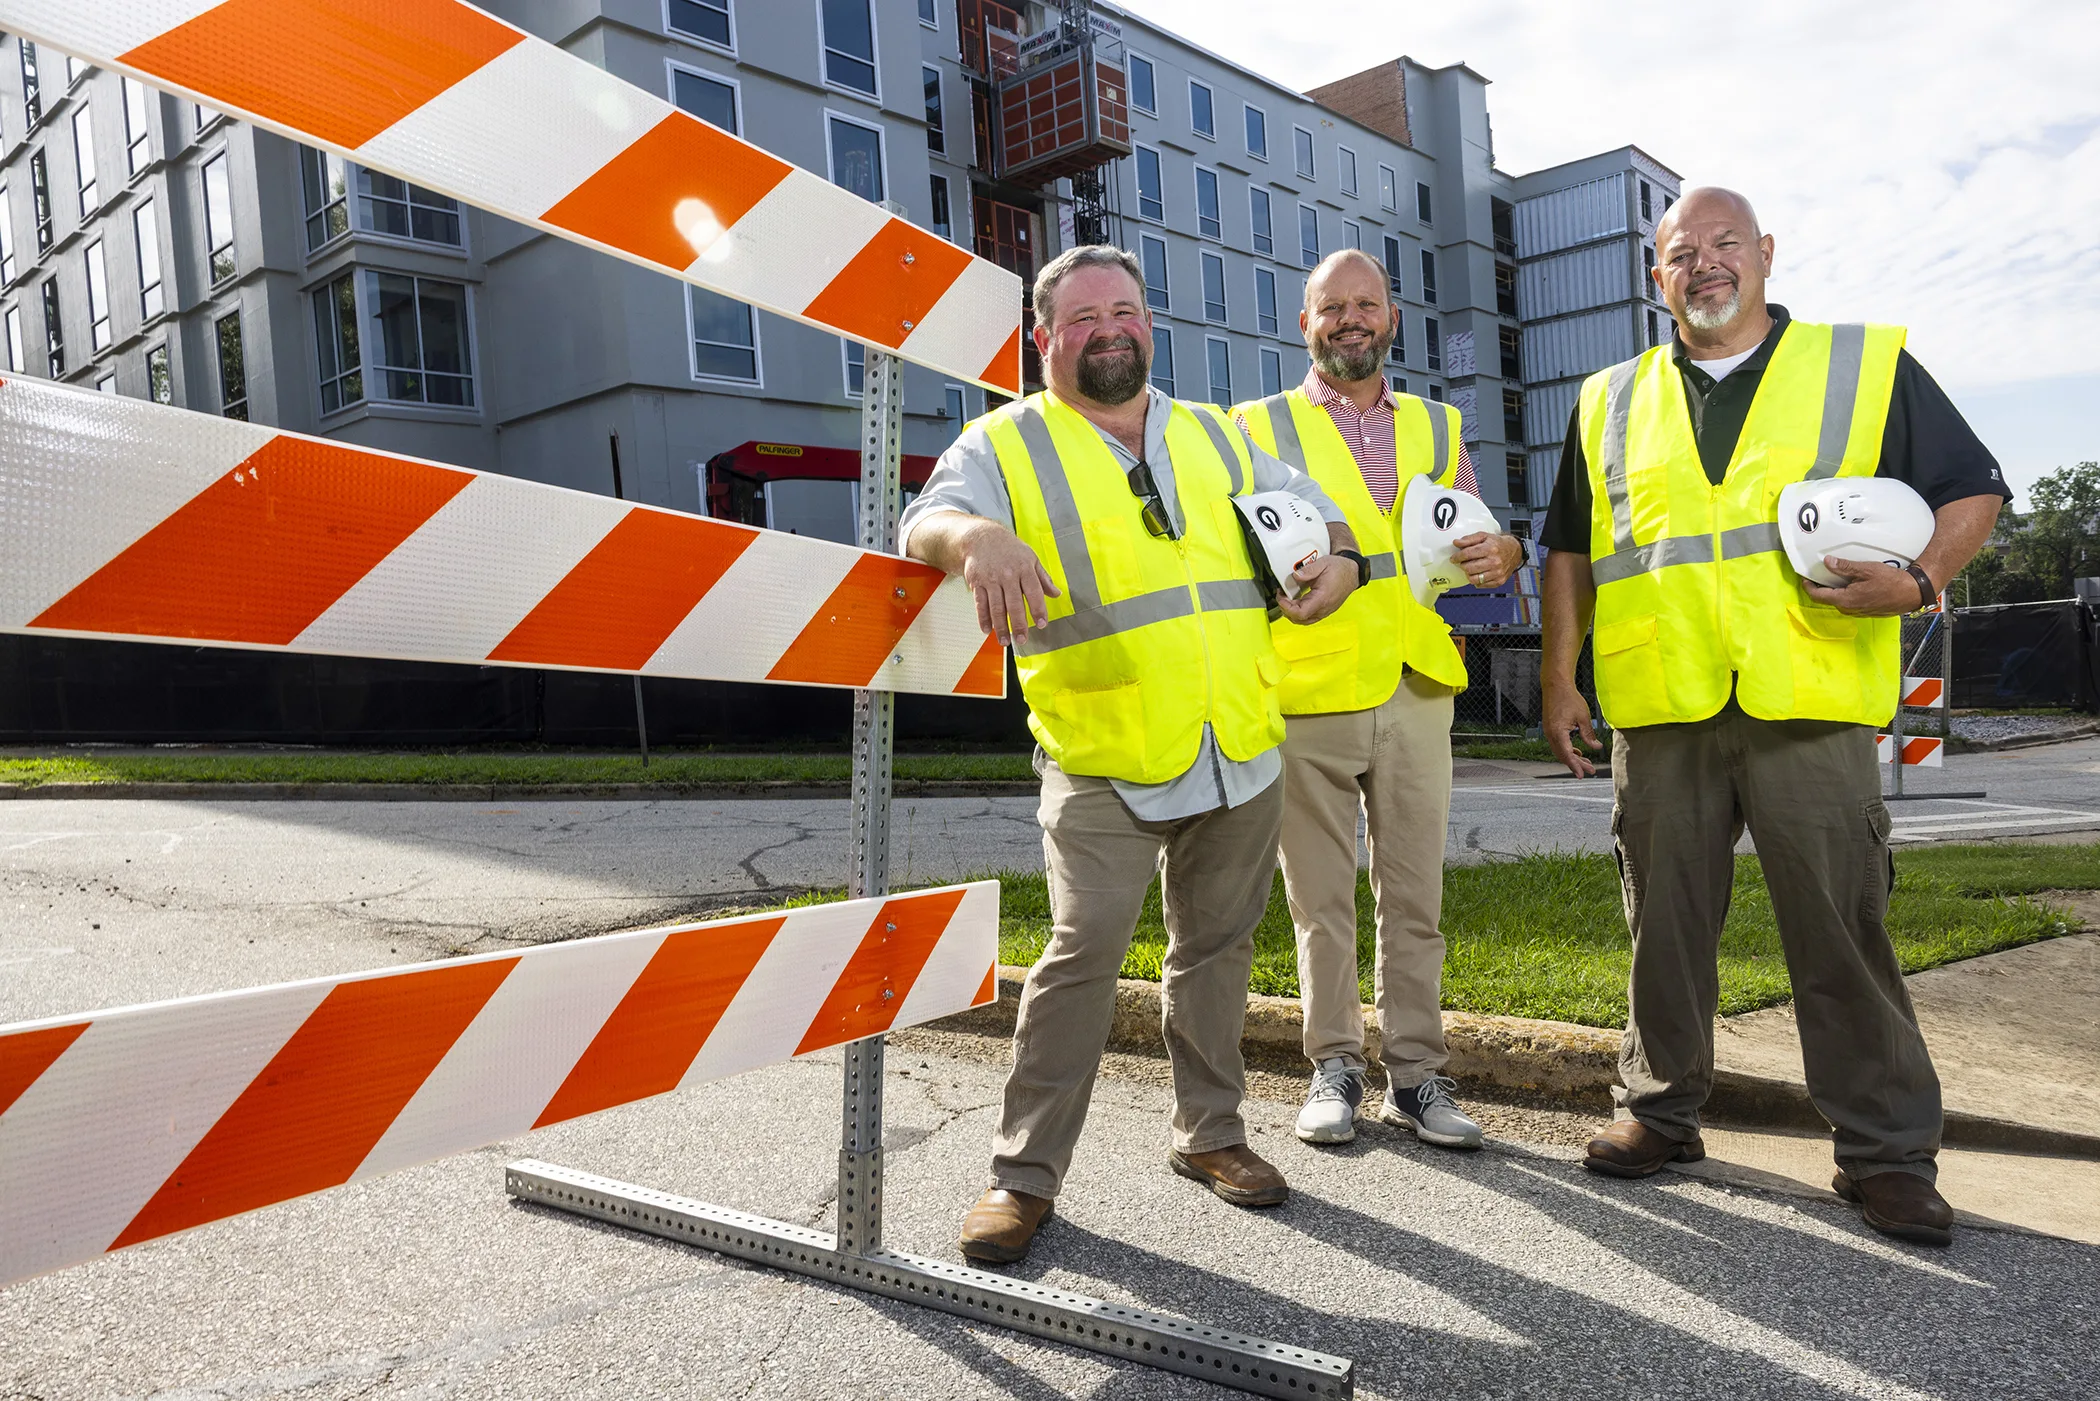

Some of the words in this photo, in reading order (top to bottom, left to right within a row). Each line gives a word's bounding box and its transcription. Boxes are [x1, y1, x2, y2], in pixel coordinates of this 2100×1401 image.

[1090, 15, 1121, 36] MAXIM
[1021, 29, 1057, 53] MAXIM
[759, 445, 801, 455] PALFINGER
[1256, 505, 1281, 531] G
[1433, 497, 1457, 530] G
[1798, 502, 1819, 532] G
